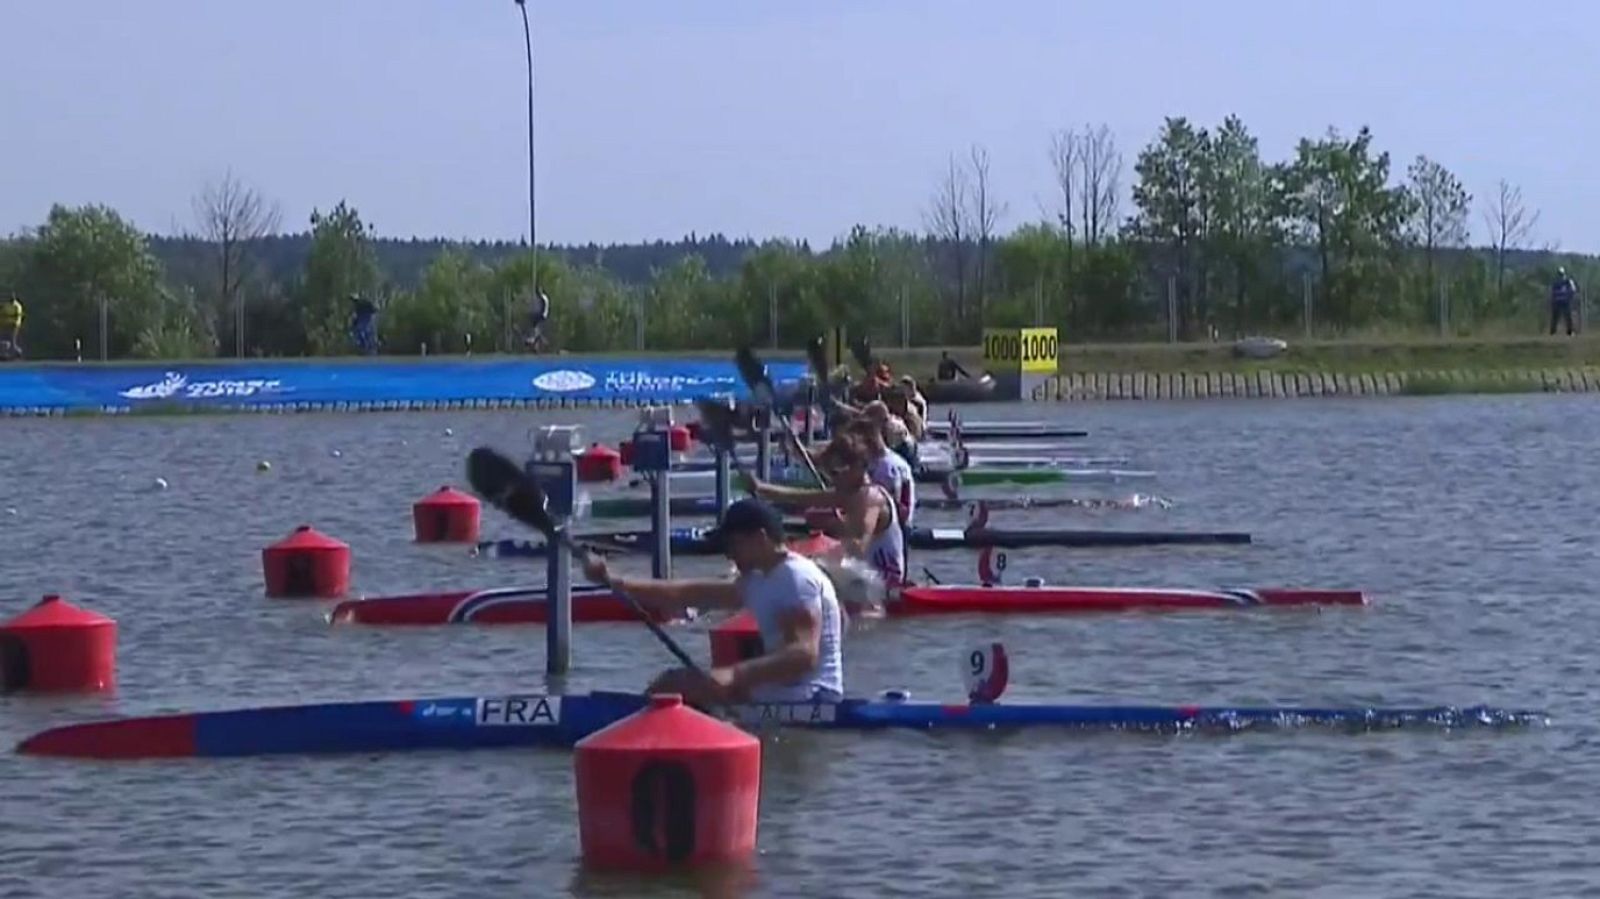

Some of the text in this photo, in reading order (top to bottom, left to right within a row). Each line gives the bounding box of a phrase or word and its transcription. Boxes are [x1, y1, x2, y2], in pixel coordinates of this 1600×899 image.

[983, 334, 1019, 360] 1000
[1022, 335, 1057, 360] 1000
[996, 552, 1007, 571] 8
[970, 651, 984, 676] 9
[482, 700, 556, 722] FRA
